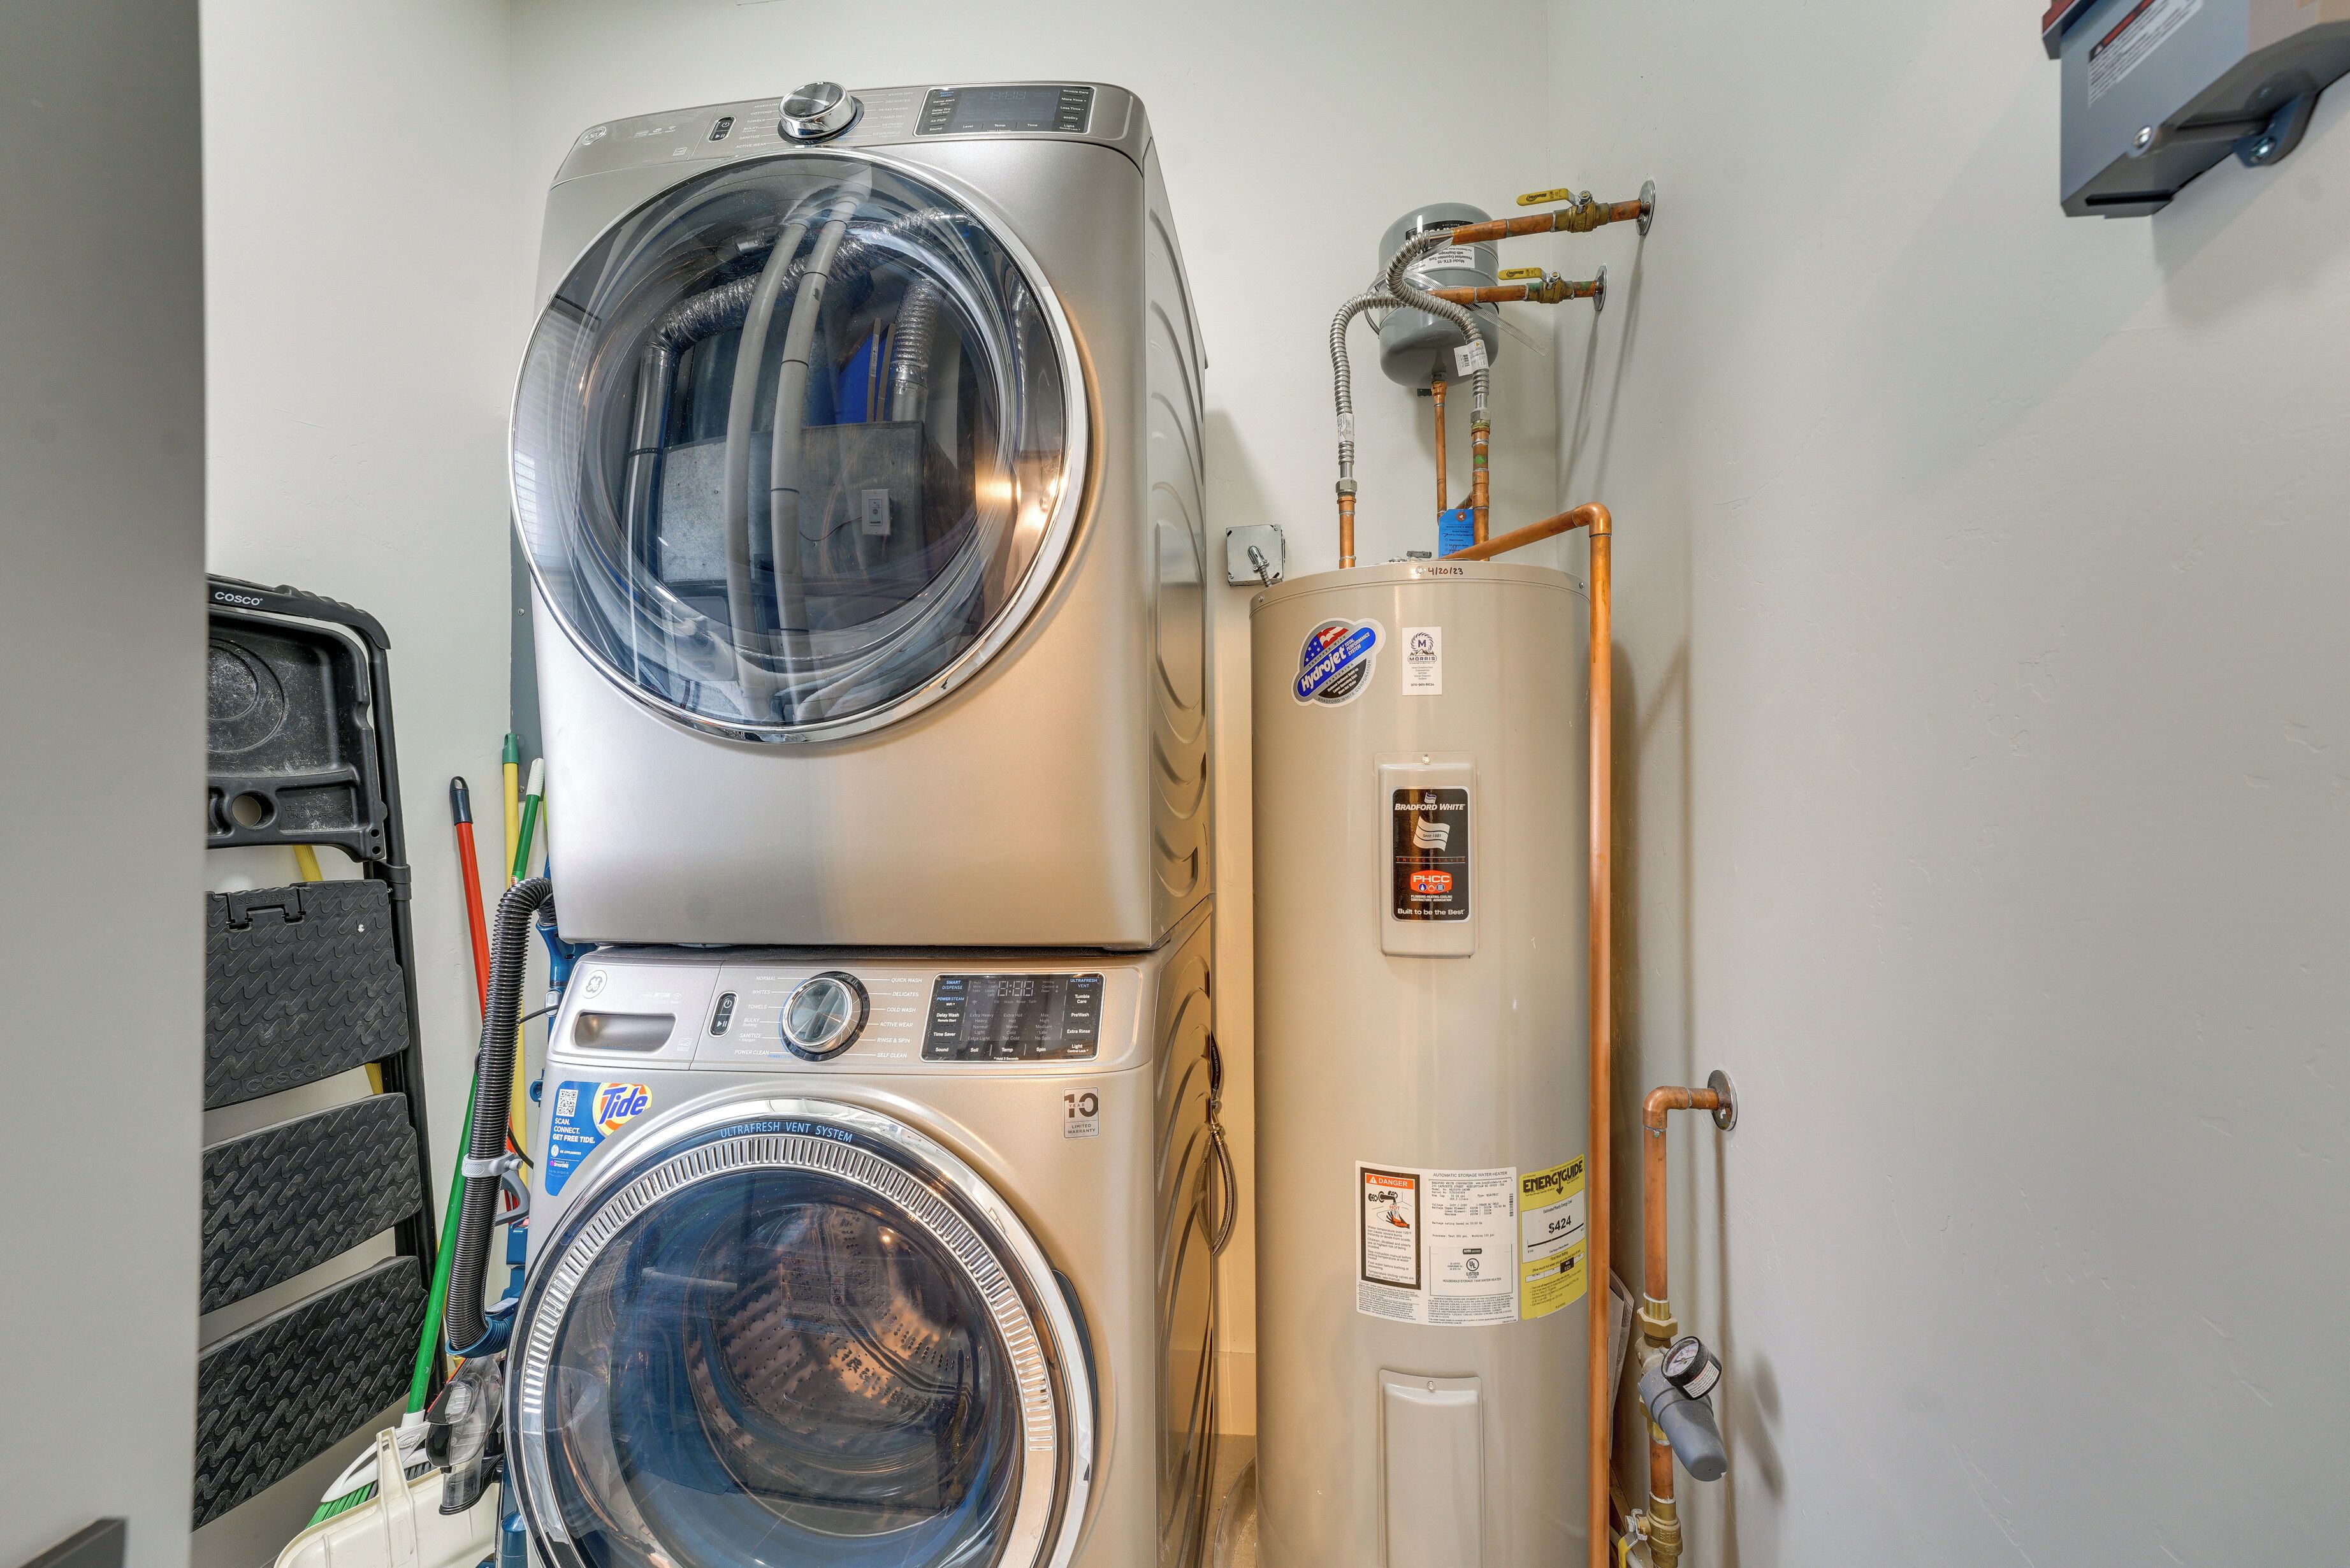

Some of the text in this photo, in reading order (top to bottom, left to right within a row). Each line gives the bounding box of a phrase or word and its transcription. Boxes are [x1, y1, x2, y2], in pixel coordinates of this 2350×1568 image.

[1428, 567, 1463, 576] 4/20/23
[215, 592, 260, 606] COSCO
[1346, 632, 1370, 651] PERFORMANCE
[1348, 644, 1361, 656] SYSTEM
[1302, 638, 1354, 692] Hydrojet TOTAL
[1326, 664, 1354, 685] FEATURING
[1342, 692, 1354, 701] WHITE
[1356, 660, 1371, 692] CORPORATION
[598, 1086, 648, 1126] Tide
[1064, 1093, 1098, 1117] 10
[554, 1126, 580, 1134] CONNECT.
[720, 1121, 853, 1143] ULTRAFRESH VENT SYSTEM
[1378, 1178, 1408, 1187] DANGER
[1523, 1159, 1583, 1194] ENERGYGUIDE
[1549, 1215, 1571, 1234] $424
